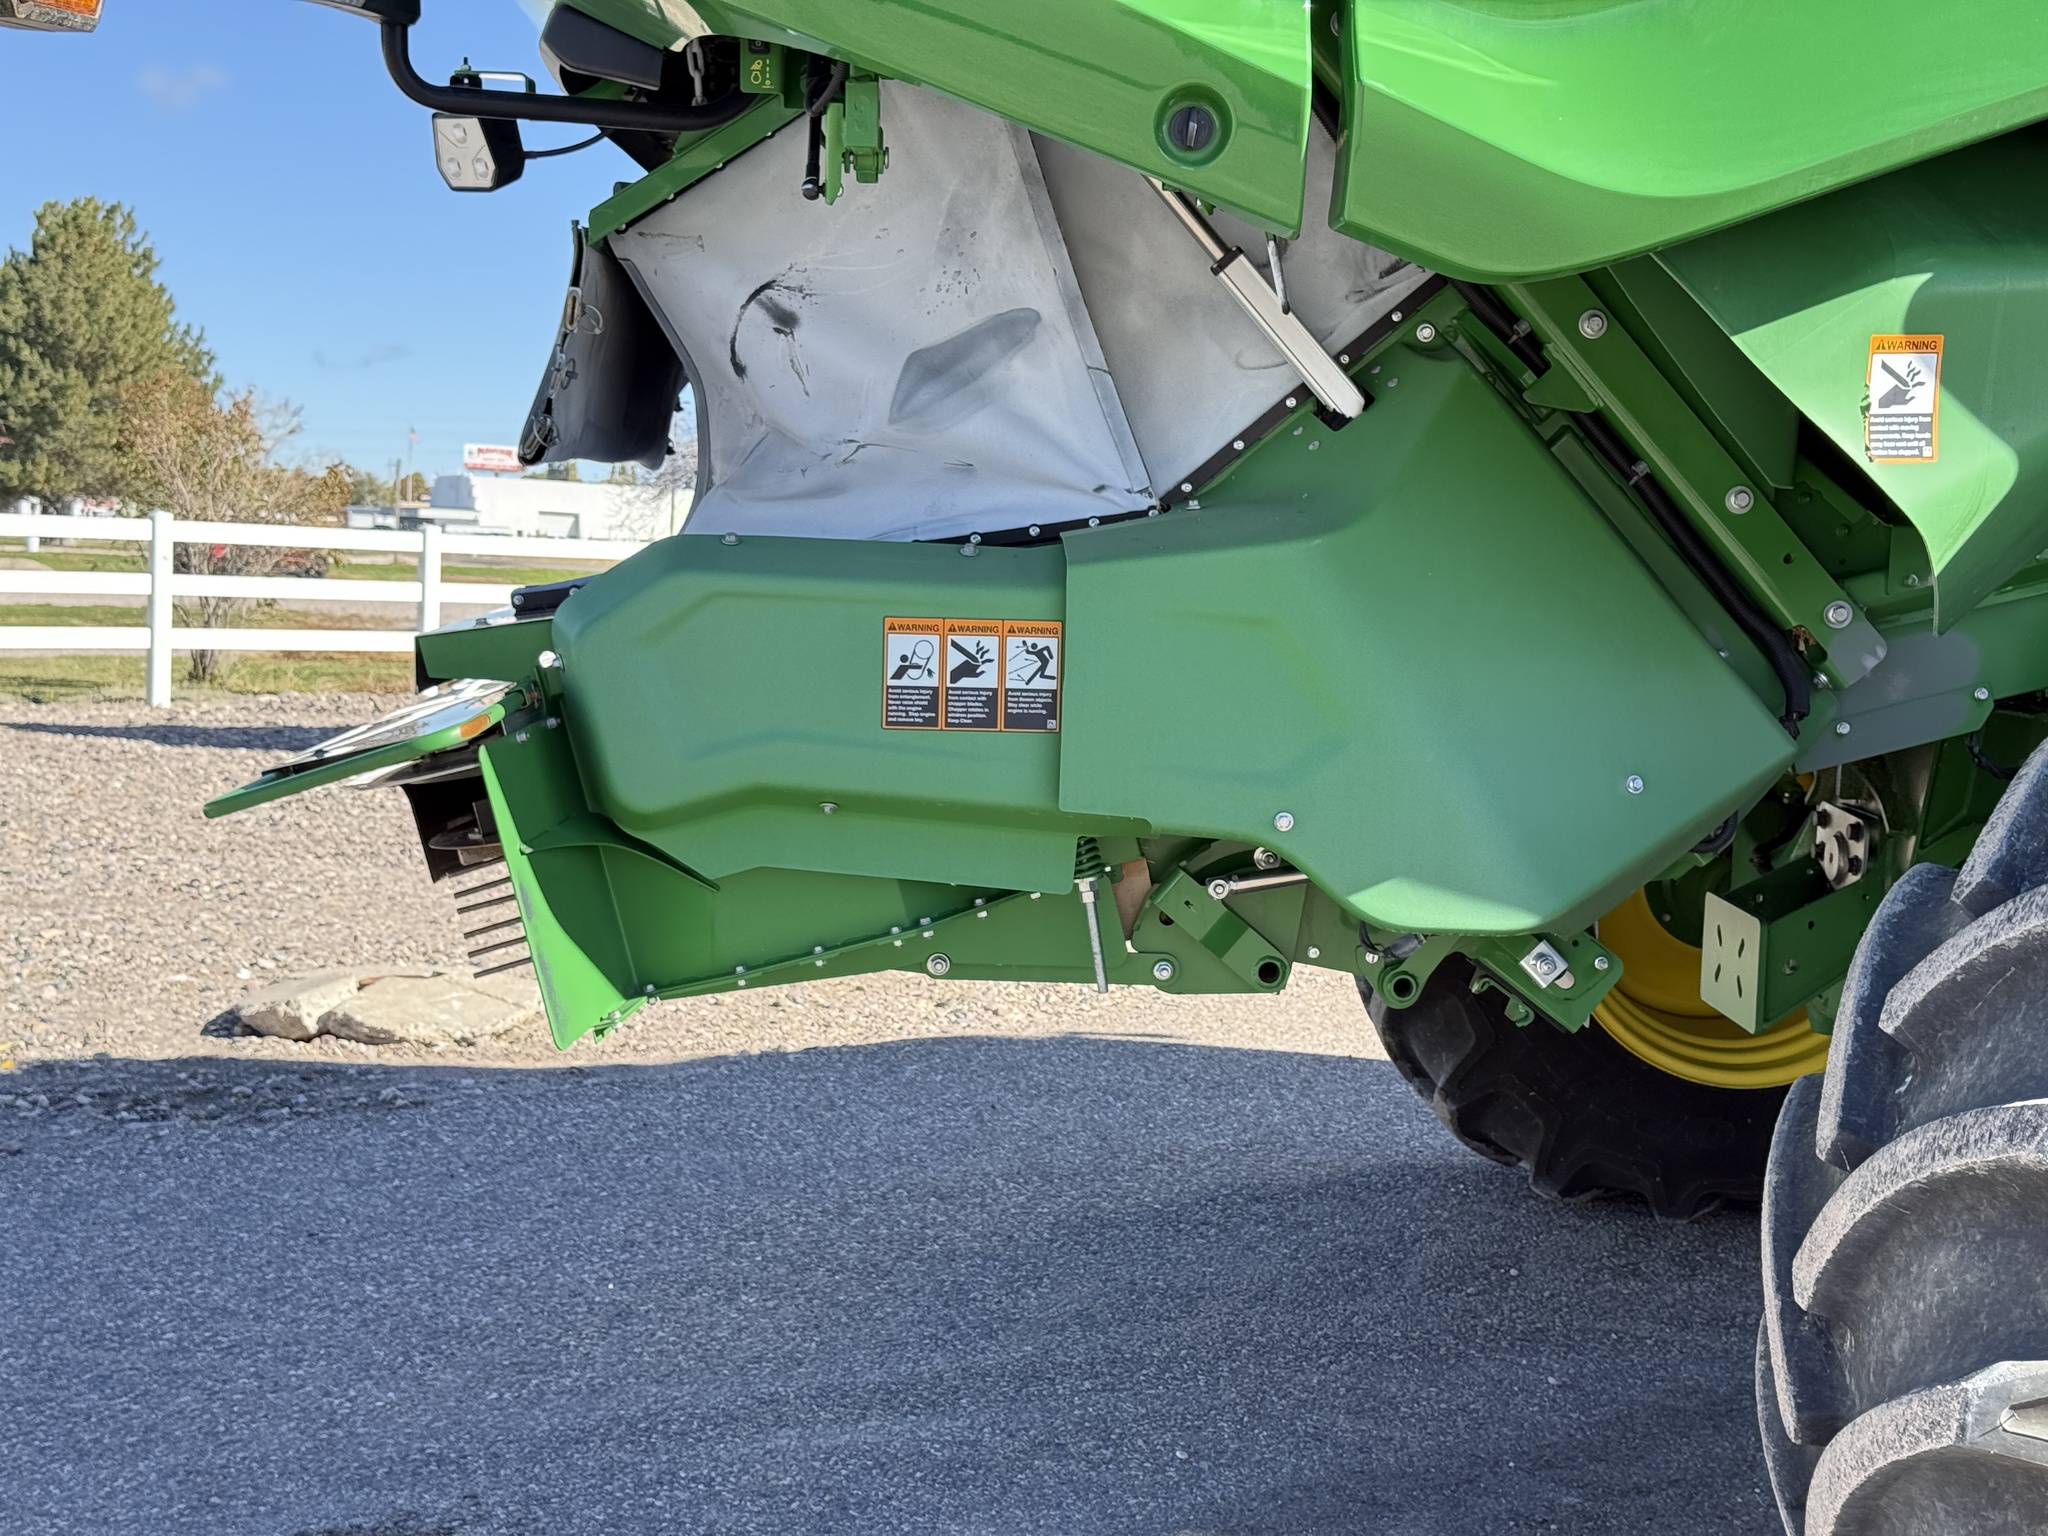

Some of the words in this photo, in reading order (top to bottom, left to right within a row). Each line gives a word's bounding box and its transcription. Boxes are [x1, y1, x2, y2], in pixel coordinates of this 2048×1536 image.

[1887, 341, 1937, 350] WARNING
[957, 625, 999, 633] WARNING
[1016, 626, 1058, 635] WARNING
